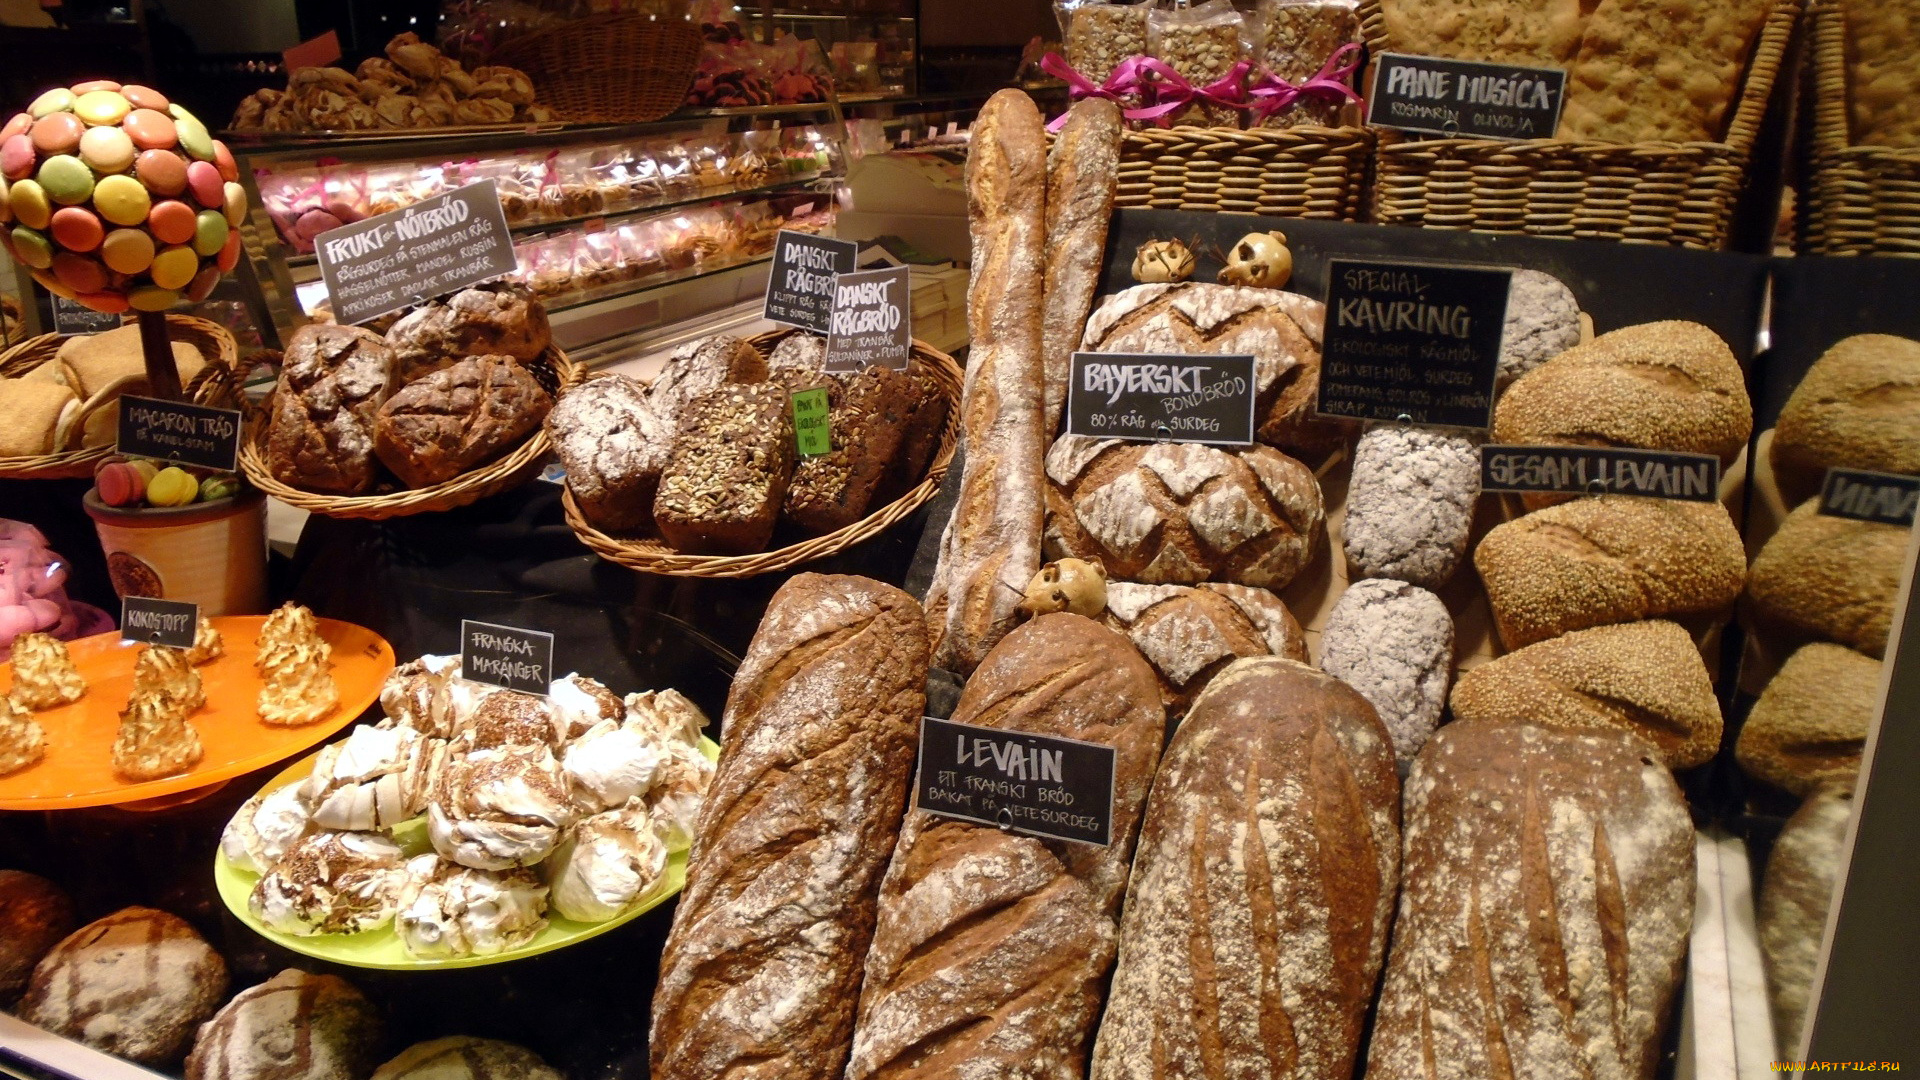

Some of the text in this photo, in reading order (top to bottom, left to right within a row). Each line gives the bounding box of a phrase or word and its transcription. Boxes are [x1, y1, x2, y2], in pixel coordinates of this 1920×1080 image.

[1387, 66, 1450, 99] PANE
[1391, 102, 1534, 134] ROSMARIN OLIVOLJA
[325, 223, 387, 264] FRUKT
[394, 196, 469, 241] NÖTBRÖD
[336, 217, 493, 283] RÅGSURDEG PÅ STENMALEN RÅG
[784, 242, 839, 271] DANSKT
[337, 236, 497, 299] HASSELNÖTTER MANDEL RUSSIN
[785, 266, 839, 296] RÅGBRÖ
[1344, 269, 1431, 295] SPECIAL
[342, 289, 395, 317] APRIKOSER
[441, 256, 494, 283] TRANBÄR
[799, 295, 815, 309] RÅG
[837, 277, 898, 309] DANSKT
[769, 304, 786, 316] VETE
[789, 309, 816, 322] SURDEG
[832, 302, 901, 336] RÅGBRÖD
[1338, 295, 1472, 338] KAVRING
[837, 331, 895, 349] MED TRANBÄR
[828, 350, 874, 363] SULTANINER
[1084, 363, 1211, 408] BAYERSKT
[1328, 361, 1350, 377] OCH
[1425, 369, 1473, 386] SURDEG
[1160, 371, 1246, 414] BONDBRÖD
[129, 407, 233, 440] MACARON TRÄD
[1121, 409, 1145, 428] RÅG
[1170, 416, 1220, 432] SURDEG
[1489, 454, 1709, 496] SESAM LEVAIN
[128, 609, 189, 632] KOKOSTOPP
[471, 632, 536, 656] FRANSKA
[472, 655, 543, 684] MARÄNGER
[957, 734, 1063, 783] LEVAIN
[938, 770, 1074, 806] ETT FRANSKT BRÖD
[929, 786, 1099, 831] BAKAT PÅ VETESURDEG
